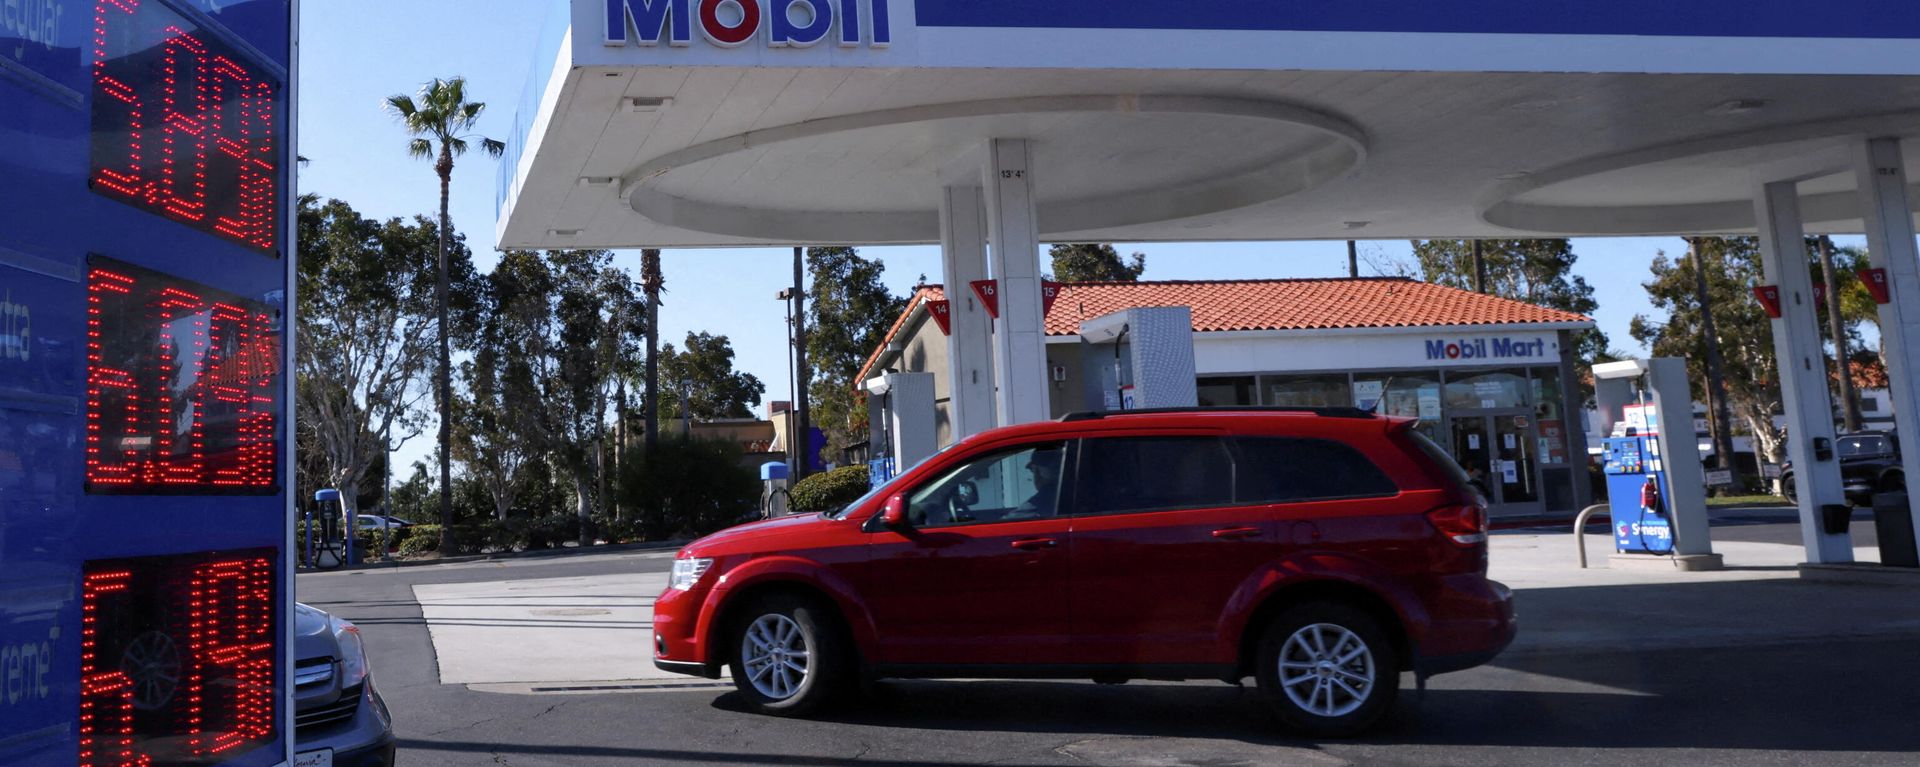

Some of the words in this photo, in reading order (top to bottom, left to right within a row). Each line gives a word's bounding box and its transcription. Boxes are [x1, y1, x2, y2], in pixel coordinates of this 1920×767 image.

[0, 0, 63, 61] egular
[604, 0, 890, 47] Mobil
[981, 285, 994, 295] 16
[1043, 287, 1055, 297] 15
[935, 304, 947, 313] 14
[1425, 339, 1487, 359] Mobil
[1492, 338, 1544, 357] Mart
